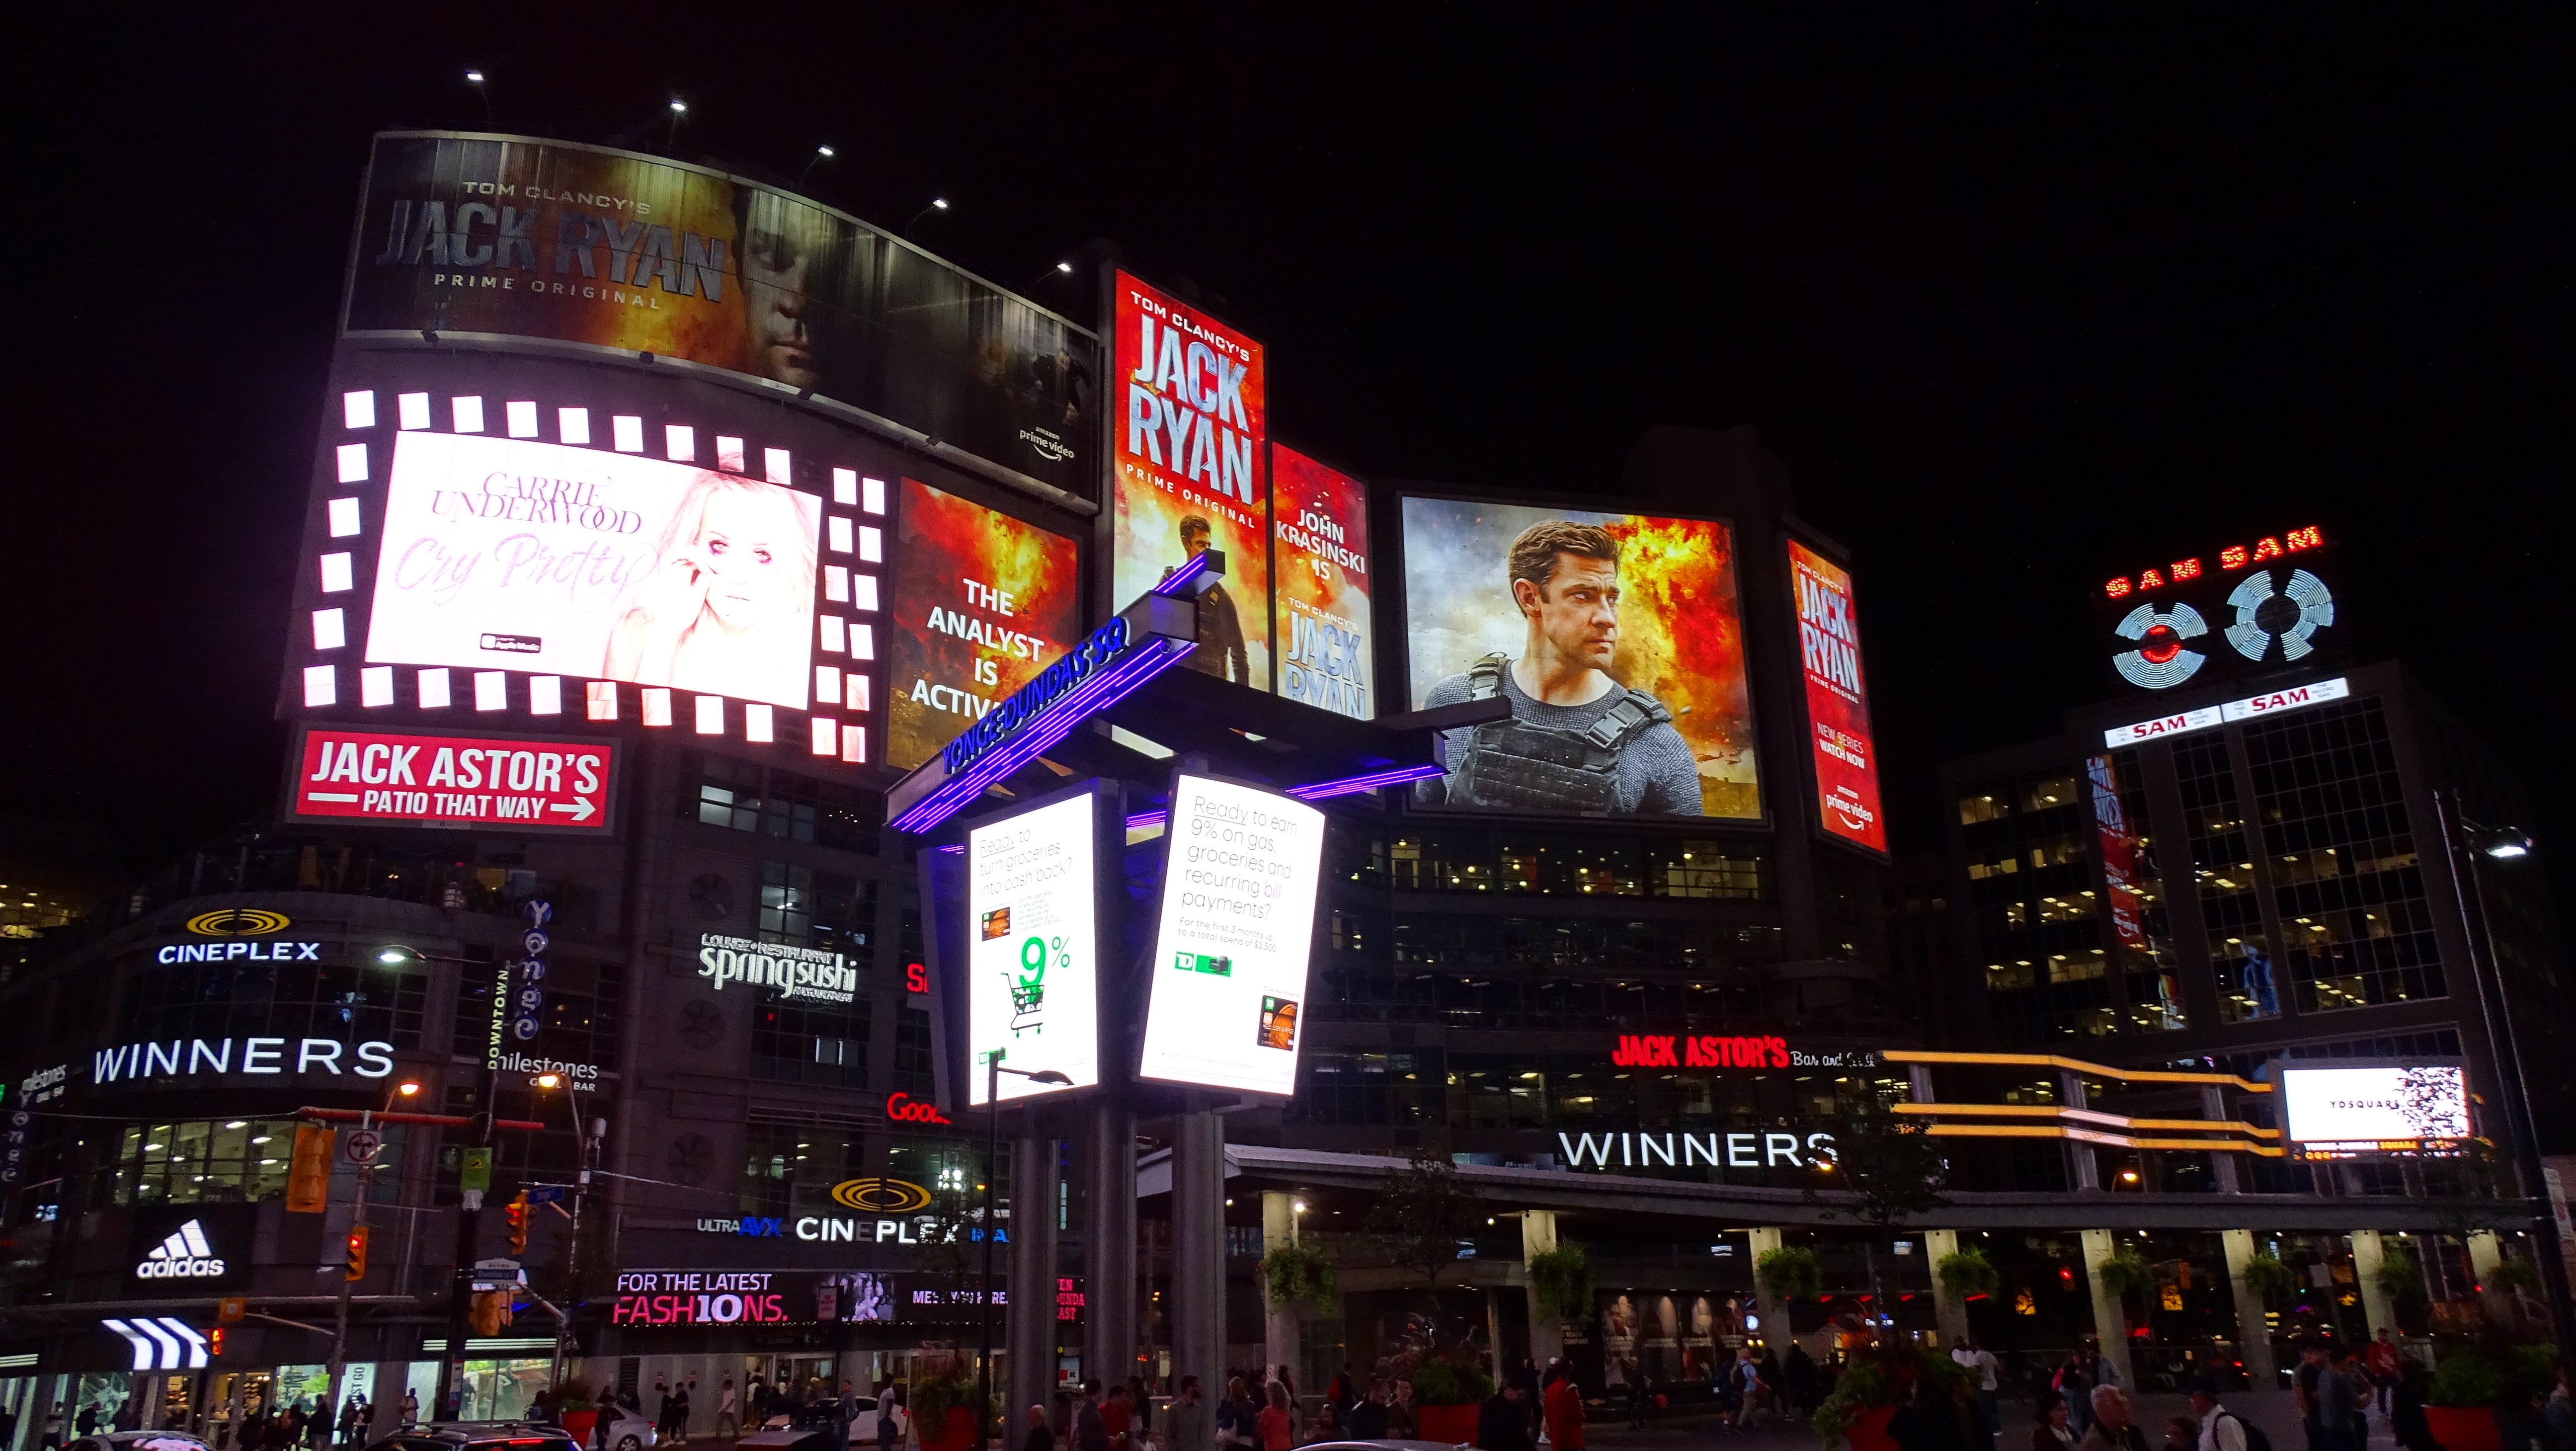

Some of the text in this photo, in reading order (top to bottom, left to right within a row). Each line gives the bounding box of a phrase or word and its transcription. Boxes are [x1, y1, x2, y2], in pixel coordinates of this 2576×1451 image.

[463, 181, 651, 215] TOM CLANCY'S
[376, 199, 727, 303] JACK RYAN
[434, 273, 660, 310] PRIME ORIGINAL
[1130, 291, 1250, 362] TOM CLANCY'S
[1134, 313, 1250, 433] JACK
[1020, 430, 1075, 458] prime video
[1036, 426, 1060, 441] amazon
[1128, 382, 1252, 507] RYAN
[483, 472, 612, 507] CARRIE
[1126, 463, 1255, 529] PRIME ORIGINAL
[431, 489, 642, 534] UNDERWOOD
[1297, 508, 1344, 544] JOHN
[1276, 520, 1366, 574] KRASINSKI
[2105, 525, 2323, 598] SAM SAM
[394, 533, 659, 613] Cry Pretty
[1313, 559, 1330, 580] IS
[1796, 561, 1812, 575] TOM
[963, 578, 1014, 617] THE
[1288, 597, 1359, 631] TOM CLANCY'S
[1800, 573, 1853, 644] JACK
[926, 606, 1045, 662] ANALYST
[1092, 616, 1130, 666] SQ
[1288, 610, 1363, 686] JACK
[974, 658, 998, 686] IS
[1801, 621, 1860, 694] RYAN
[1285, 660, 1365, 720] RYAN
[1810, 674, 1829, 689] PRIME
[910, 679, 1001, 721] ACTIV
[2252, 688, 2310, 711] SAM
[1817, 722, 1864, 754] NEW SERIES
[2133, 716, 2186, 738] SAM
[311, 741, 600, 794] JACK ASTOR'S
[1819, 738, 1865, 769] WATCH NOW
[363, 790, 546, 819] PATIO THAT WAY
[1194, 796, 1297, 836] Ready to earn
[1826, 794, 1873, 822] prime video
[980, 830, 1031, 855] Ready to
[1191, 818, 1277, 854] 9% on gas,
[980, 842, 1060, 876] turn groceries
[1188, 845, 1292, 879] groceries and
[980, 857, 1072, 897] into cash back?
[1185, 869, 1282, 899] recurring bill
[1182, 892, 1271, 920] payments?
[1180, 917, 1194, 926] For
[1197, 920, 1210, 929] the
[1212, 922, 1228, 932] first
[1237, 928, 1263, 939] months
[1198, 931, 1217, 941] total
[1219, 936, 1243, 947] spend
[158, 942, 321, 964] CINEPLEX
[514, 900, 550, 1040] Yonge
[487, 969, 509, 1070] DOWNTOWN
[94, 1037, 396, 1085] WINNERS
[1612, 1035, 1678, 1067] JACK
[1685, 1035, 1788, 1068] ASTOR'S
[1790, 1050, 1819, 1066] Bar
[573, 1082, 596, 1092] BAR
[1558, 1132, 1839, 1168] WINNERS
[136, 1256, 225, 1280] adidas
[617, 1274, 772, 1291] FOR THE LATEST
